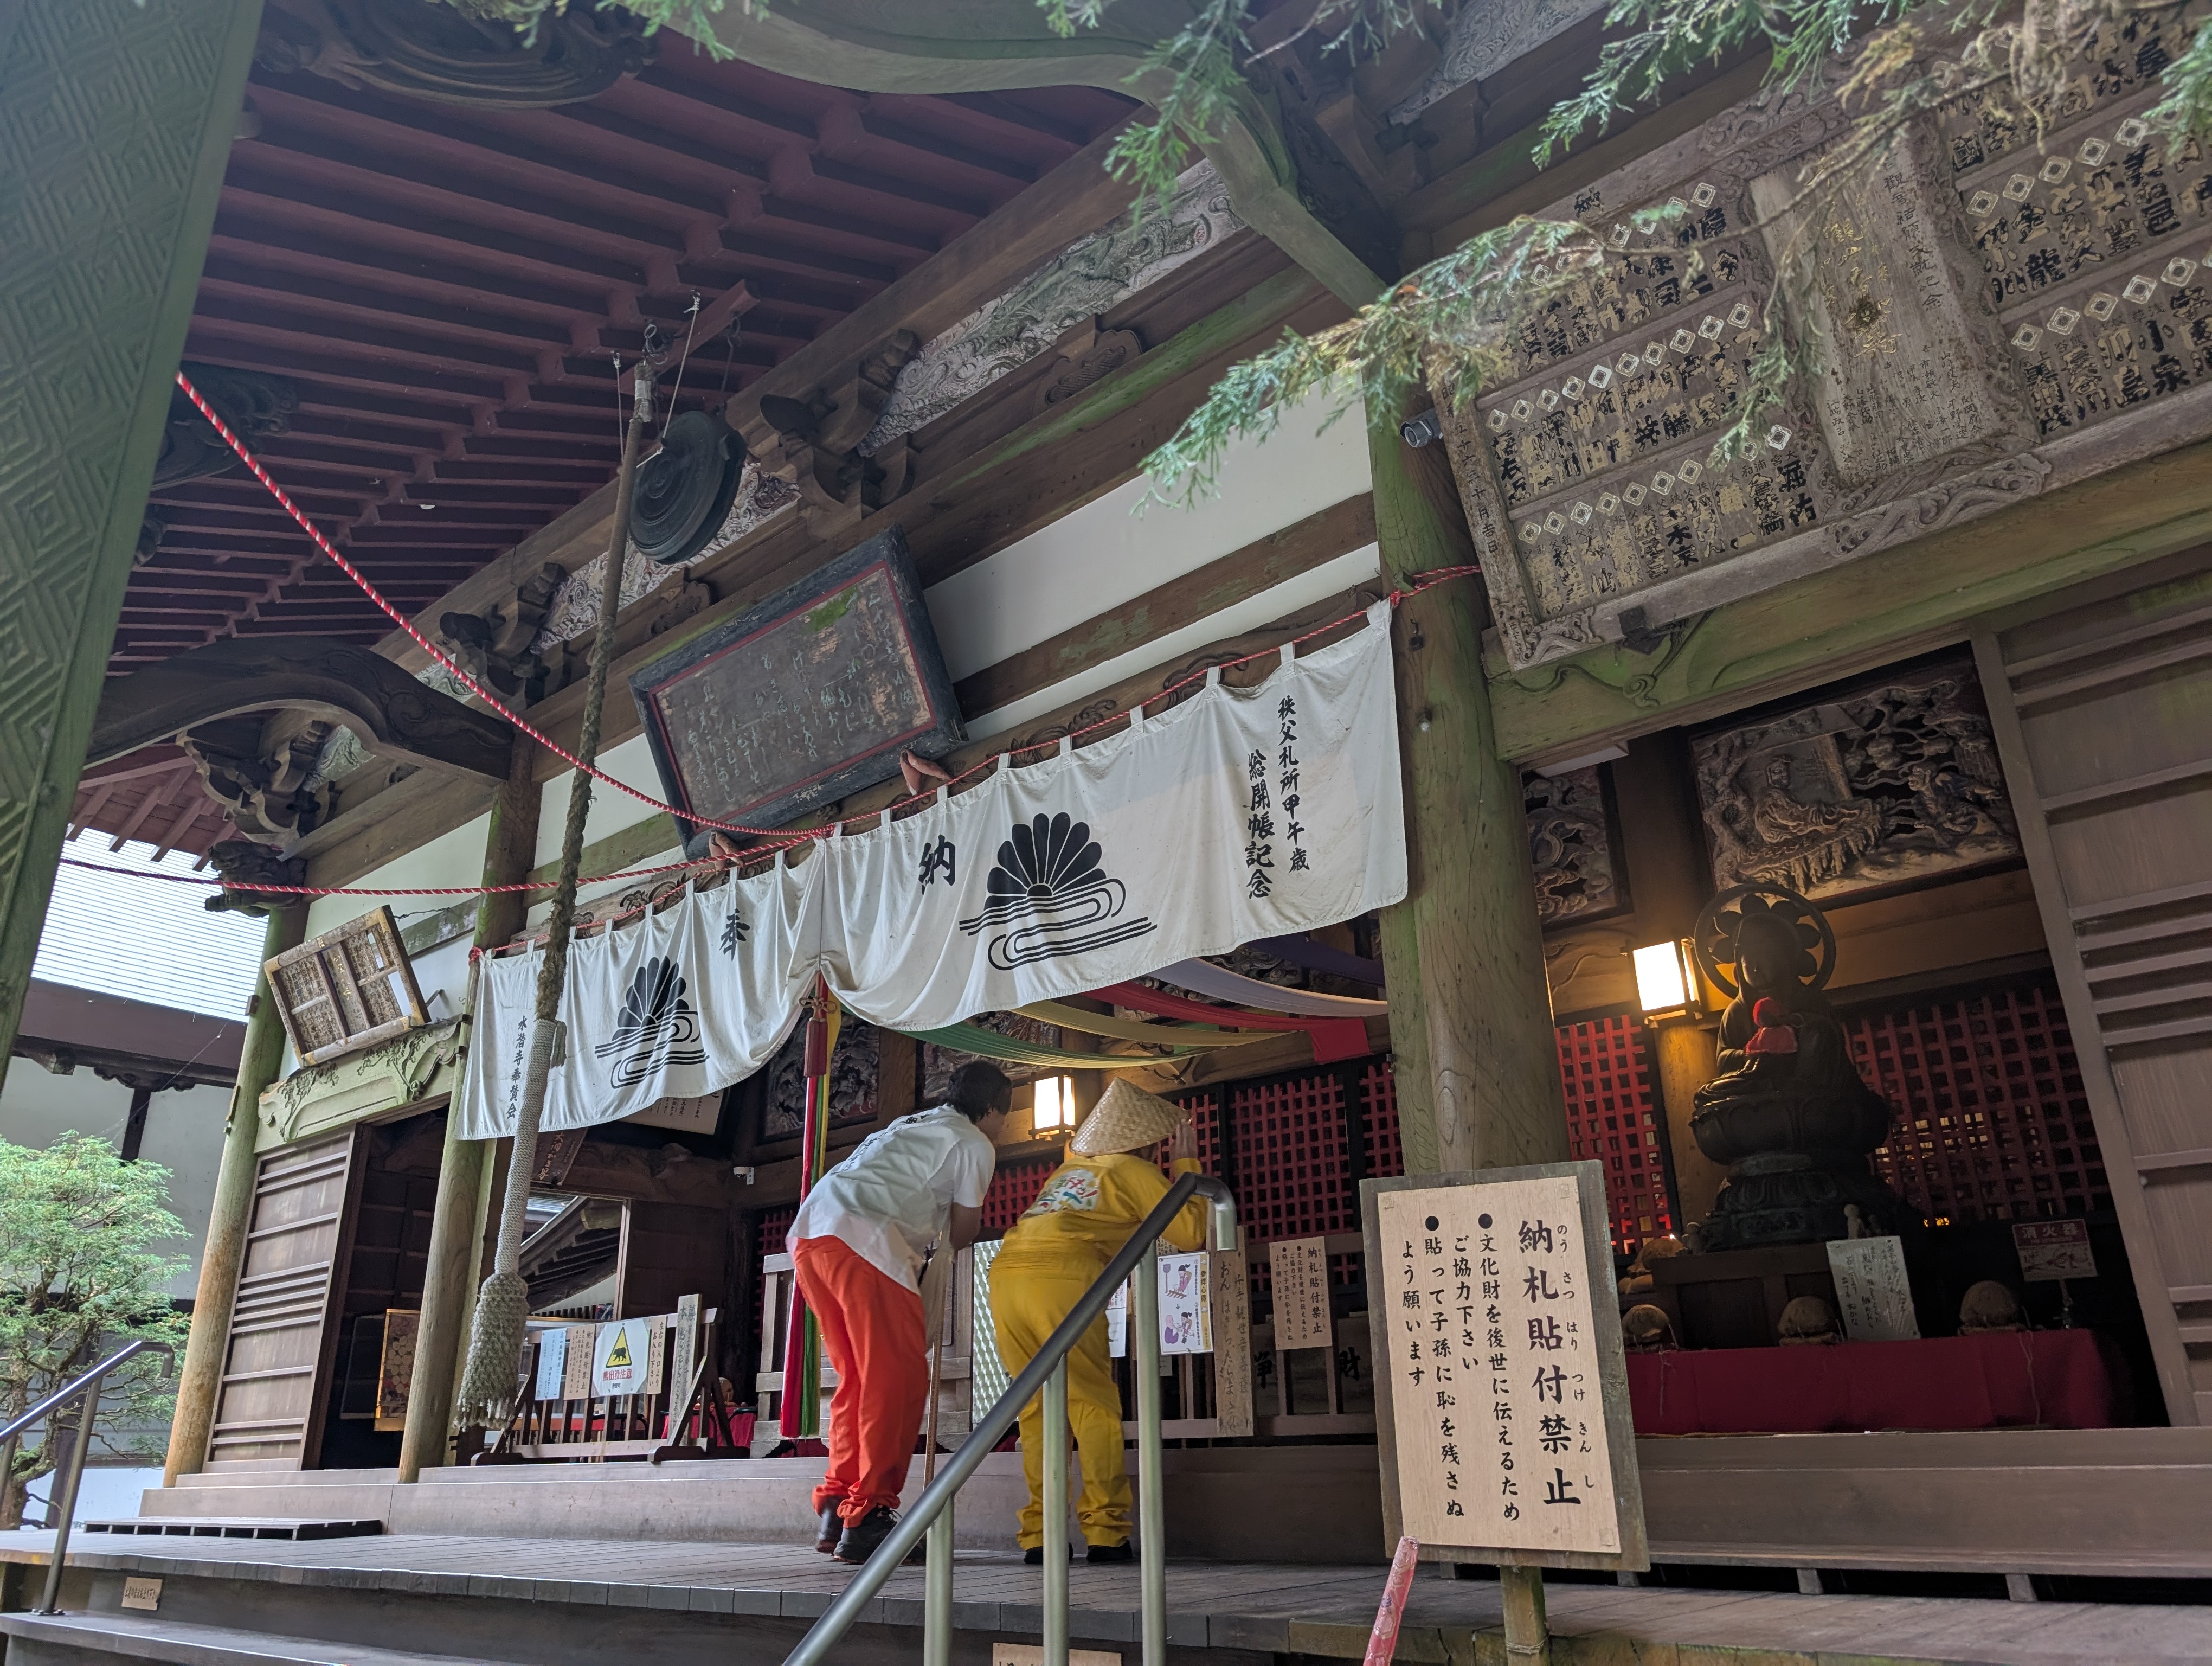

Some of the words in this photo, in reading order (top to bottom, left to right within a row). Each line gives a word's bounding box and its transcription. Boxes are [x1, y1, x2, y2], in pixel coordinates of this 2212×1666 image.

[1278, 695, 1310, 873] 秩父札所甲午歳
[918, 834, 955, 895] 納
[719, 908, 750, 961] 奉
[1308, 1247, 1323, 1334] 納札貼付禁止
[1401, 1240, 1425, 1386] よう願います
[1453, 1236, 1478, 1370] ご協力下さい
[603, 1368, 633, 1381] 熊出没注意
[649, 1332, 657, 1386] お入り下さい
[1424, 1237, 1464, 1517] 貼って子孫に恥を残さぬ
[1479, 1234, 1520, 1521] 文化財を後世に伝えるため
[1519, 1220, 1581, 1505] 納札貼付禁止
